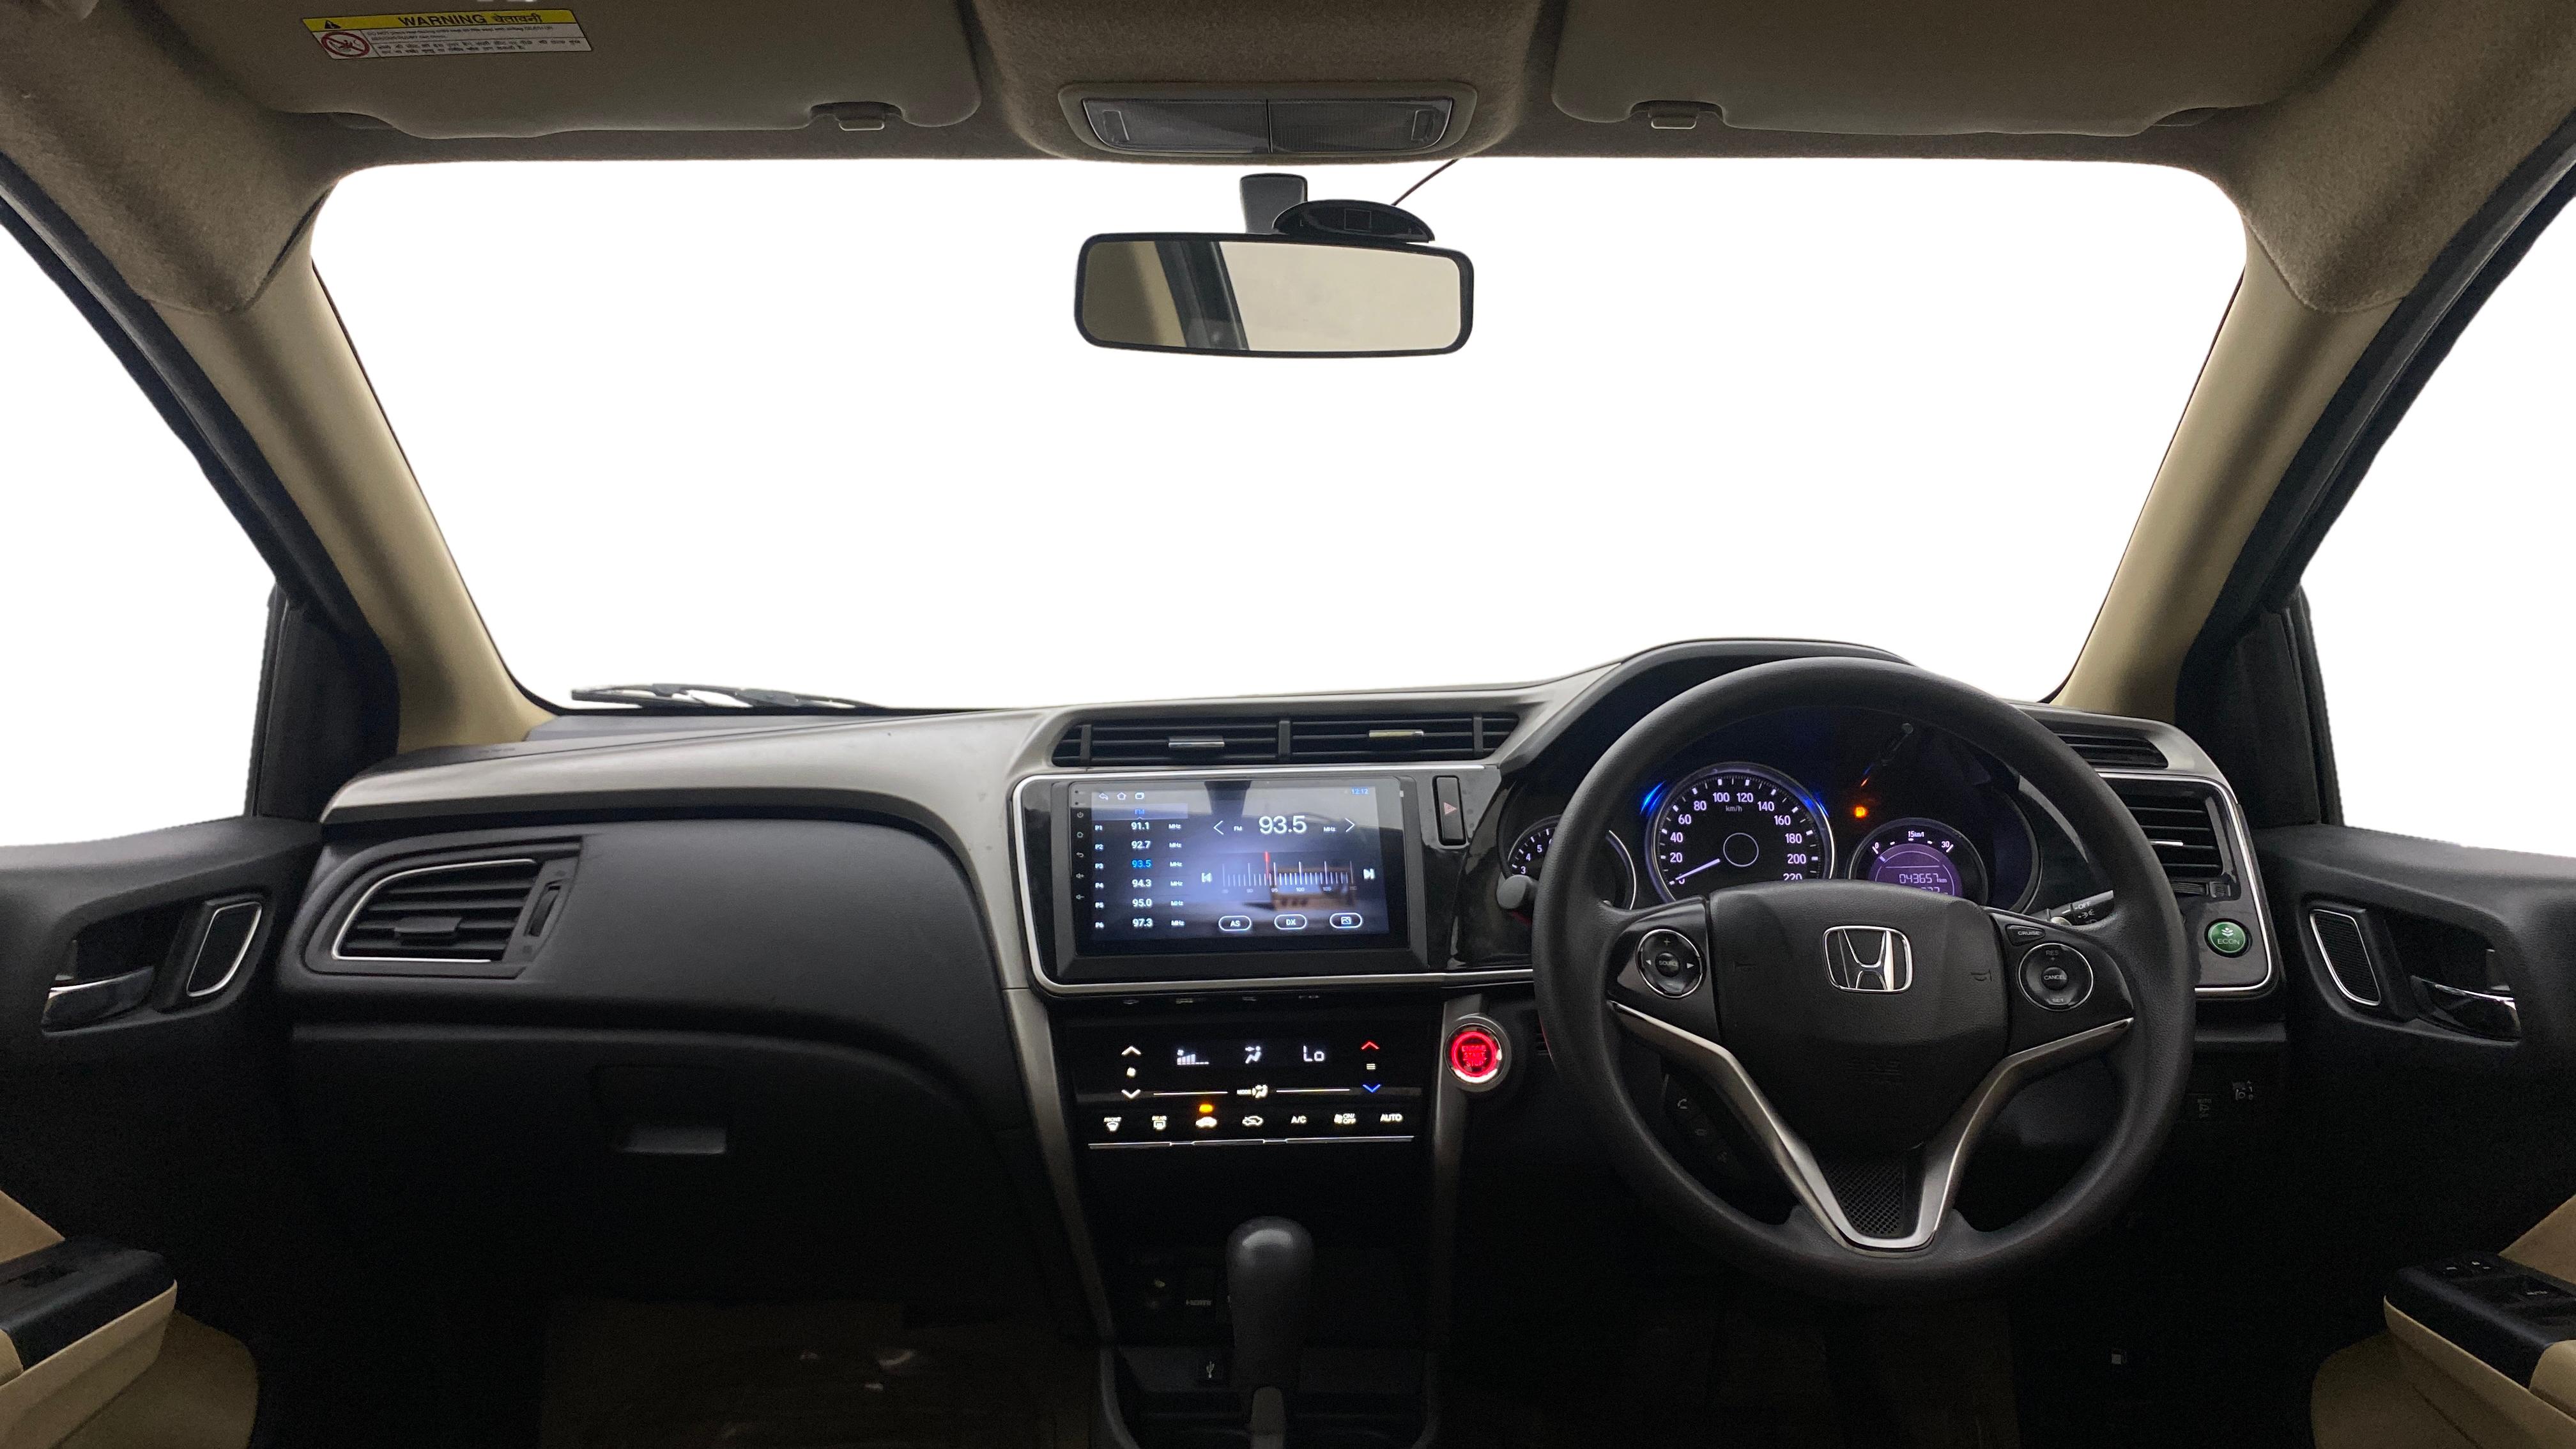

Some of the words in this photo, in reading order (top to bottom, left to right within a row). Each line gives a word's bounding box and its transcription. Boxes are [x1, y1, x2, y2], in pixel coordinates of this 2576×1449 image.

[398, 14, 487, 26] WARNING
[491, 13, 542, 24] चेतावनी
[1713, 792, 1729, 803] 100
[1736, 792, 1754, 803] 120
[1693, 801, 1707, 811] 80
[1758, 801, 1775, 811] 140
[1258, 815, 1307, 834] 93.5
[1678, 814, 1692, 825] 60
[1774, 815, 1791, 825] 160
[1131, 822, 1149, 830] 91.1
[1670, 832, 1683, 843] 40
[1785, 833, 1802, 844] 180
[1131, 841, 1151, 849] 92.7
[1537, 844, 1542, 853] 5
[1526, 853, 1531, 861] 4
[1669, 852, 1683, 862] 20
[1787, 854, 1807, 864] 200
[1131, 859, 1152, 868] 93.5
[1521, 866, 1526, 874] 3
[1131, 879, 1152, 887] 94.3
[1899, 873, 1938, 884] 043657
[1132, 898, 1153, 907] 95.0
[2078, 901, 2091, 910] OFF
[1132, 918, 1153, 927] 97.3
[1303, 1045, 1325, 1062] Lo
